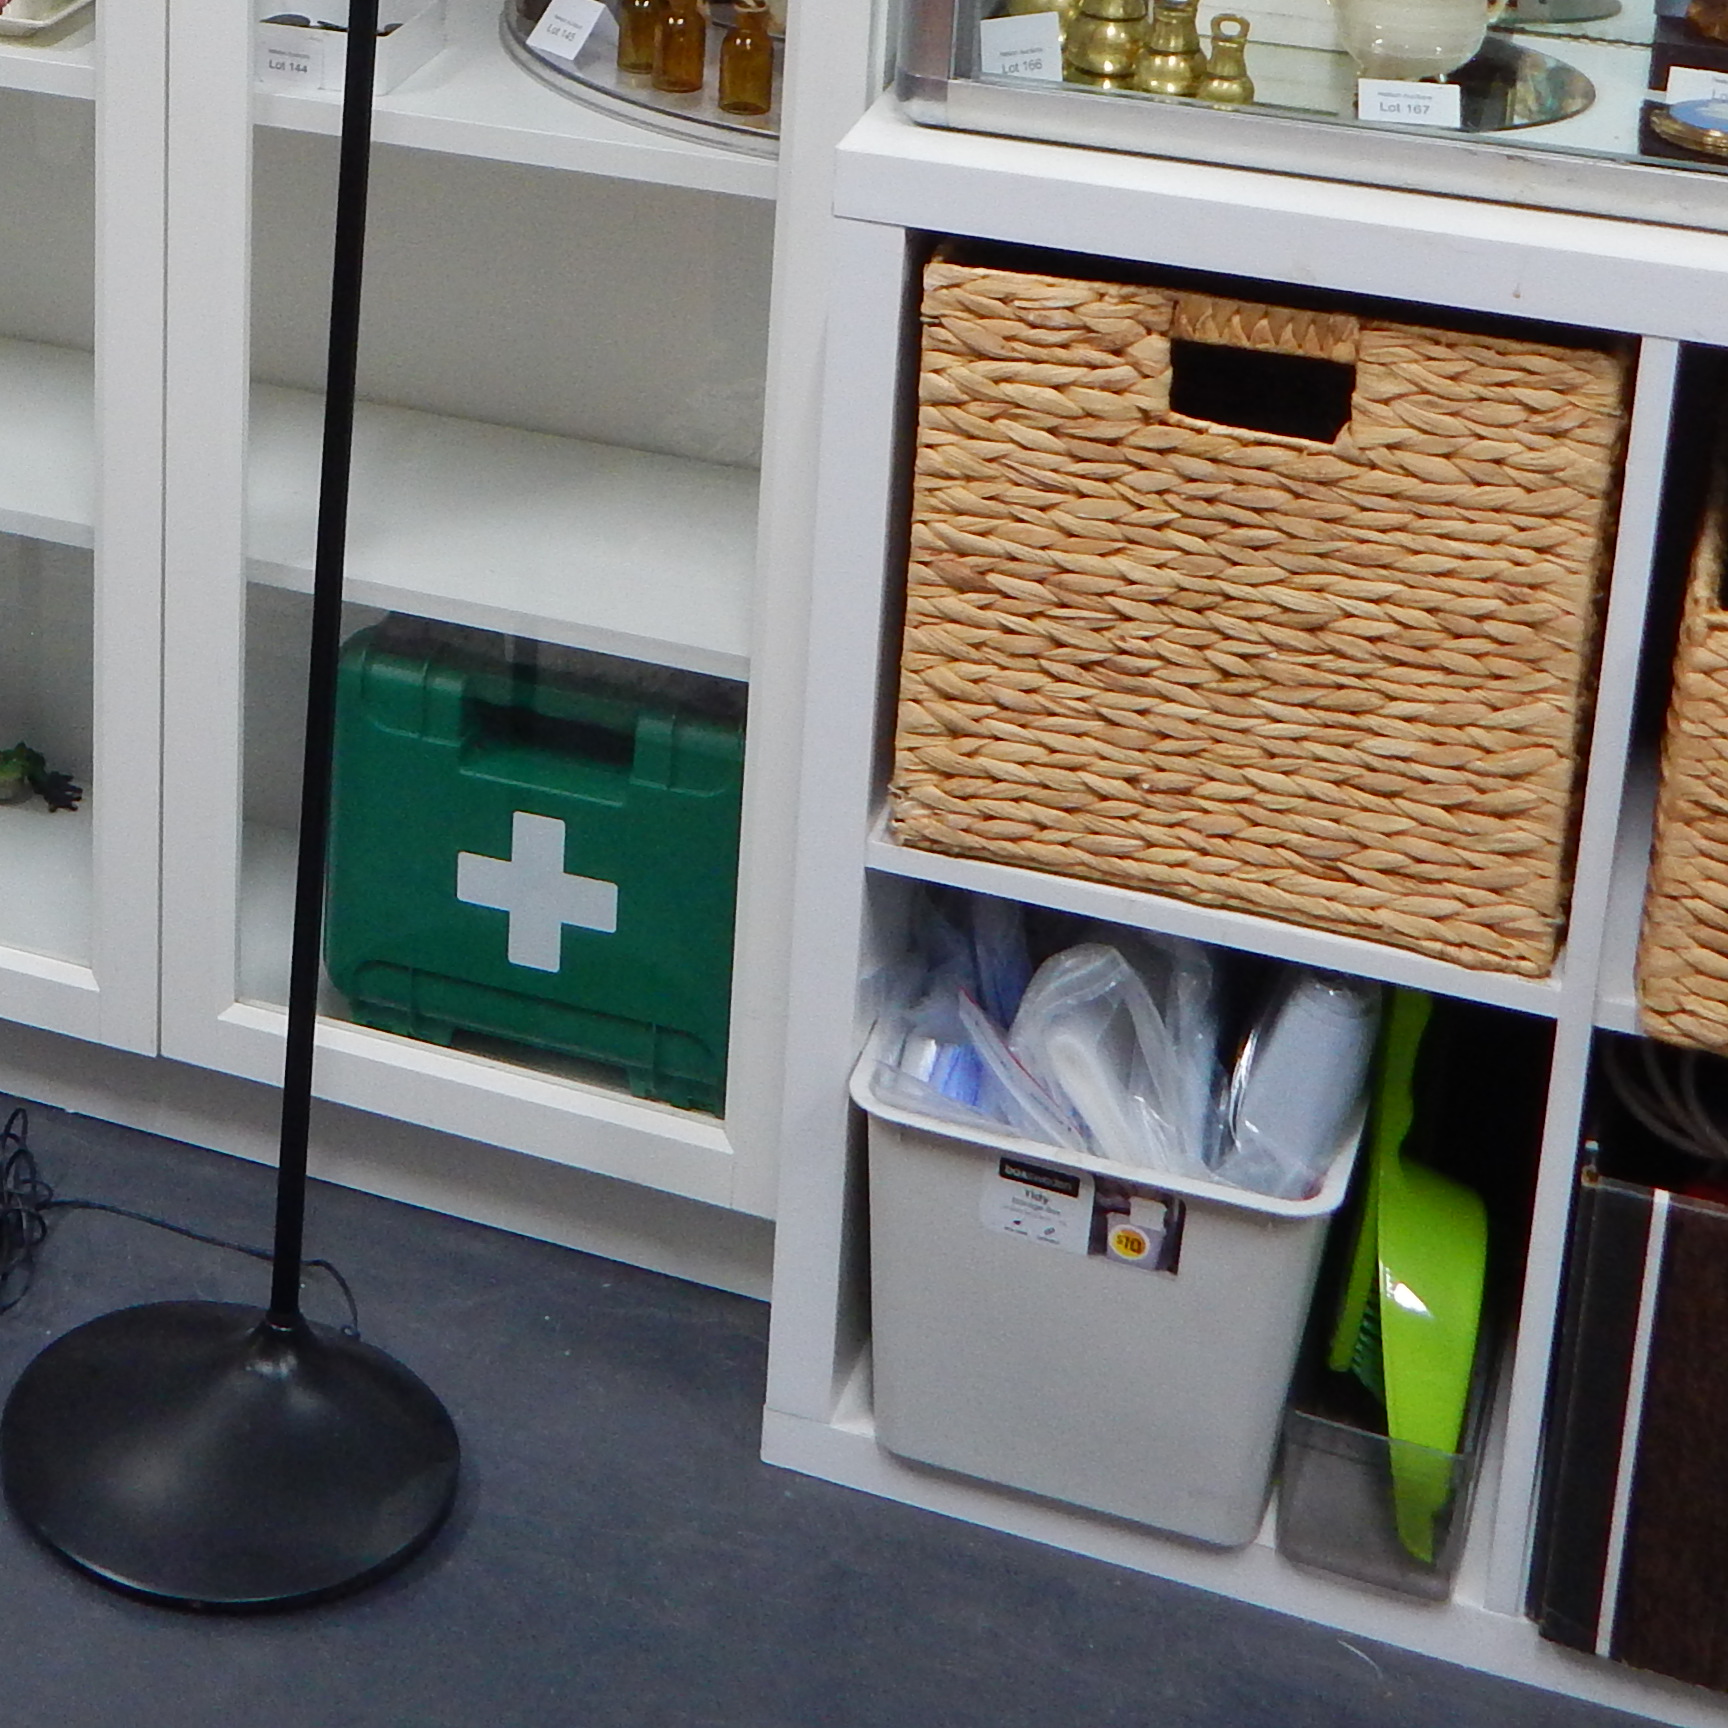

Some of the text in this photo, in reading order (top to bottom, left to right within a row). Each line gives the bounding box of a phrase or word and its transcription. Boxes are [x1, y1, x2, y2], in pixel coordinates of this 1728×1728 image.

[269, 59, 286, 71] Lot
[1002, 61, 1020, 74] Lot
[1379, 101, 1431, 115] Lot 167
